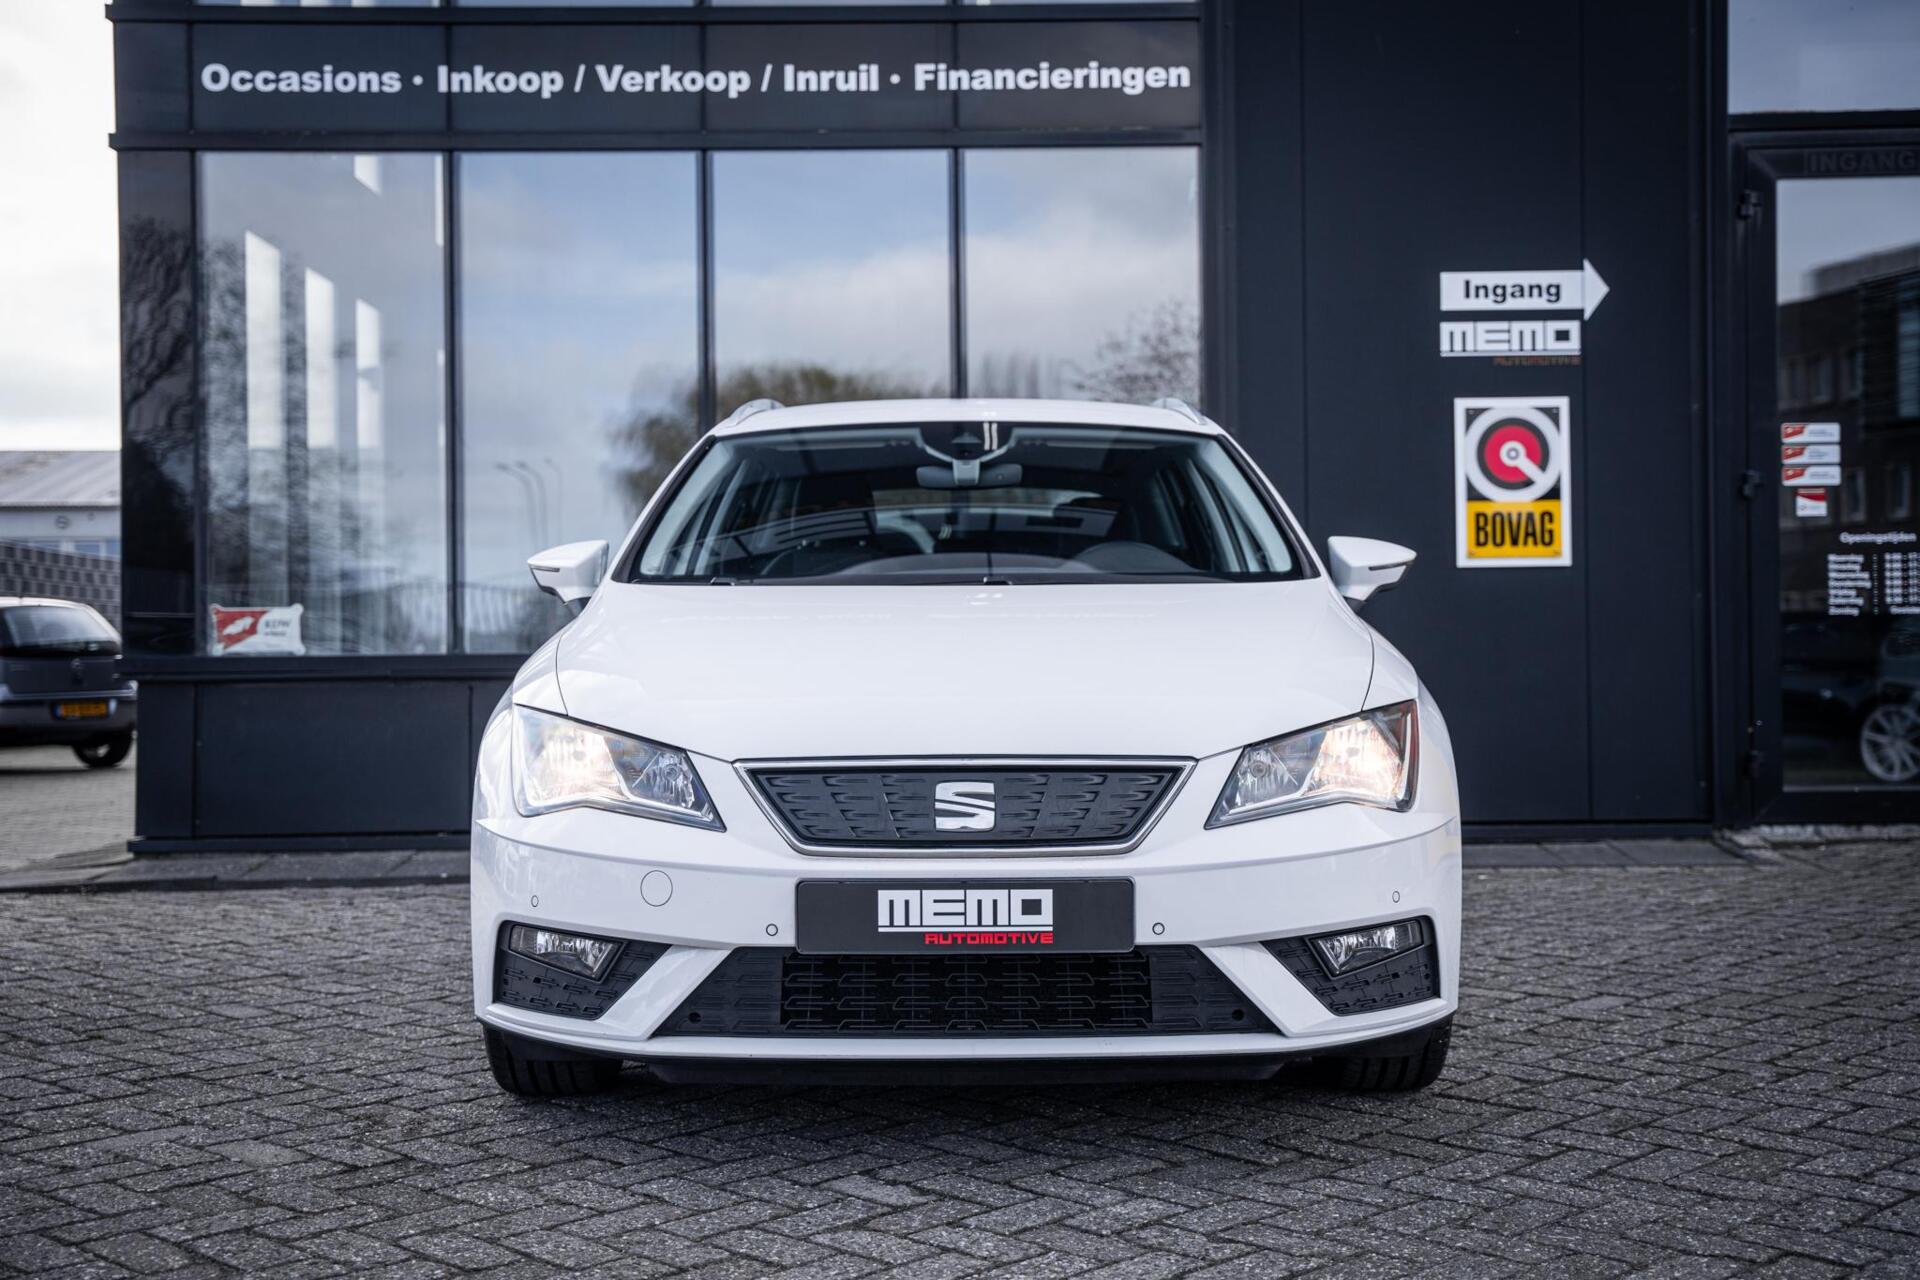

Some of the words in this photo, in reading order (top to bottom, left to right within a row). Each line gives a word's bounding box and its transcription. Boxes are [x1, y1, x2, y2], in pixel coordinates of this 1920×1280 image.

[201, 63, 402, 94] Occasions
[437, 64, 564, 99] Inkoop
[594, 63, 751, 99] Verkoop
[783, 63, 879, 92] Inruil
[914, 61, 1191, 96] Financieringen
[1810, 150, 1917, 172] INGANG
[1463, 279, 1562, 304] Ingang
[1440, 320, 1581, 352] MEMO
[1474, 511, 1555, 547] BOVAG
[878, 889, 1054, 926] MEMO
[925, 932, 1053, 945] AUTOMOTIVE
